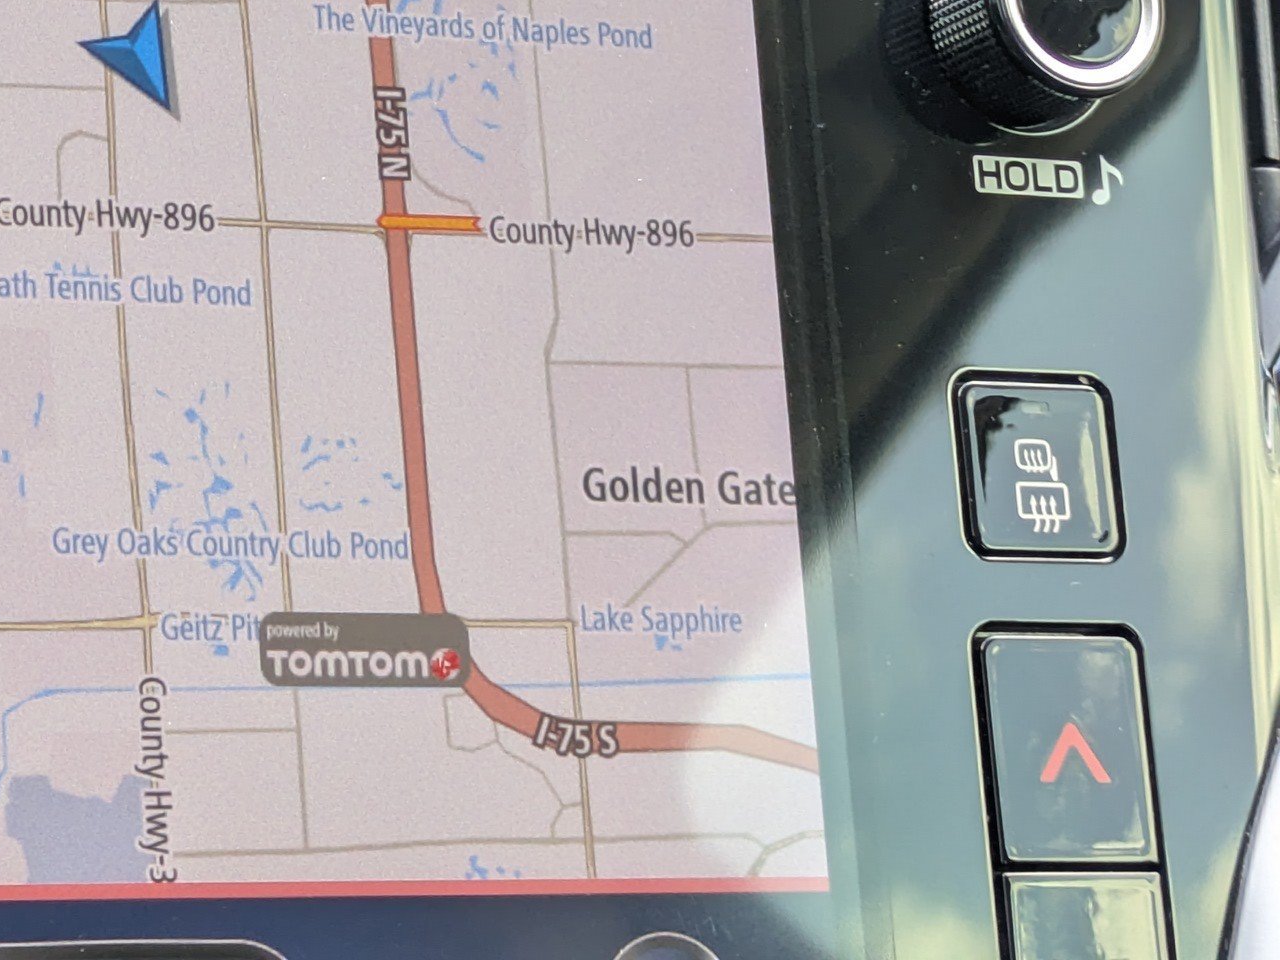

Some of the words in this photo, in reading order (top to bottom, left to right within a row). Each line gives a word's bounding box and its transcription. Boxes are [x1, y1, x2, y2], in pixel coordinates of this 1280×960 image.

[313, 4, 355, 32] The
[361, 7, 474, 41] Vineyards
[482, 14, 506, 40] of
[512, 17, 591, 51] Naples
[598, 23, 654, 50] Pond
[375, 86, 409, 150] I-75
[379, 154, 411, 180] N
[977, 159, 1081, 200] HOLD
[95, 200, 216, 238] Hwy-896
[489, 215, 576, 254] County
[583, 218, 695, 254] Hwy-896
[45, 272, 122, 303] Tennis
[130, 275, 184, 305] Club
[193, 279, 252, 307] Pond
[582, 467, 705, 505] Golden
[718, 470, 797, 507] Gate
[52, 526, 109, 563] Grey
[117, 527, 179, 557] Oaks
[186, 530, 280, 564] Country
[288, 530, 342, 559] Club
[350, 532, 409, 560] Pond
[161, 612, 222, 642] Geitz
[232, 613, 261, 641] Pit
[266, 622, 320, 641] powered
[322, 621, 340, 642] by
[580, 604, 633, 632] Lake
[640, 604, 743, 637] Sapphire
[135, 677, 169, 784] County
[533, 715, 594, 757] I-75
[598, 723, 620, 758] S
[138, 790, 178, 884] Hwy-3
